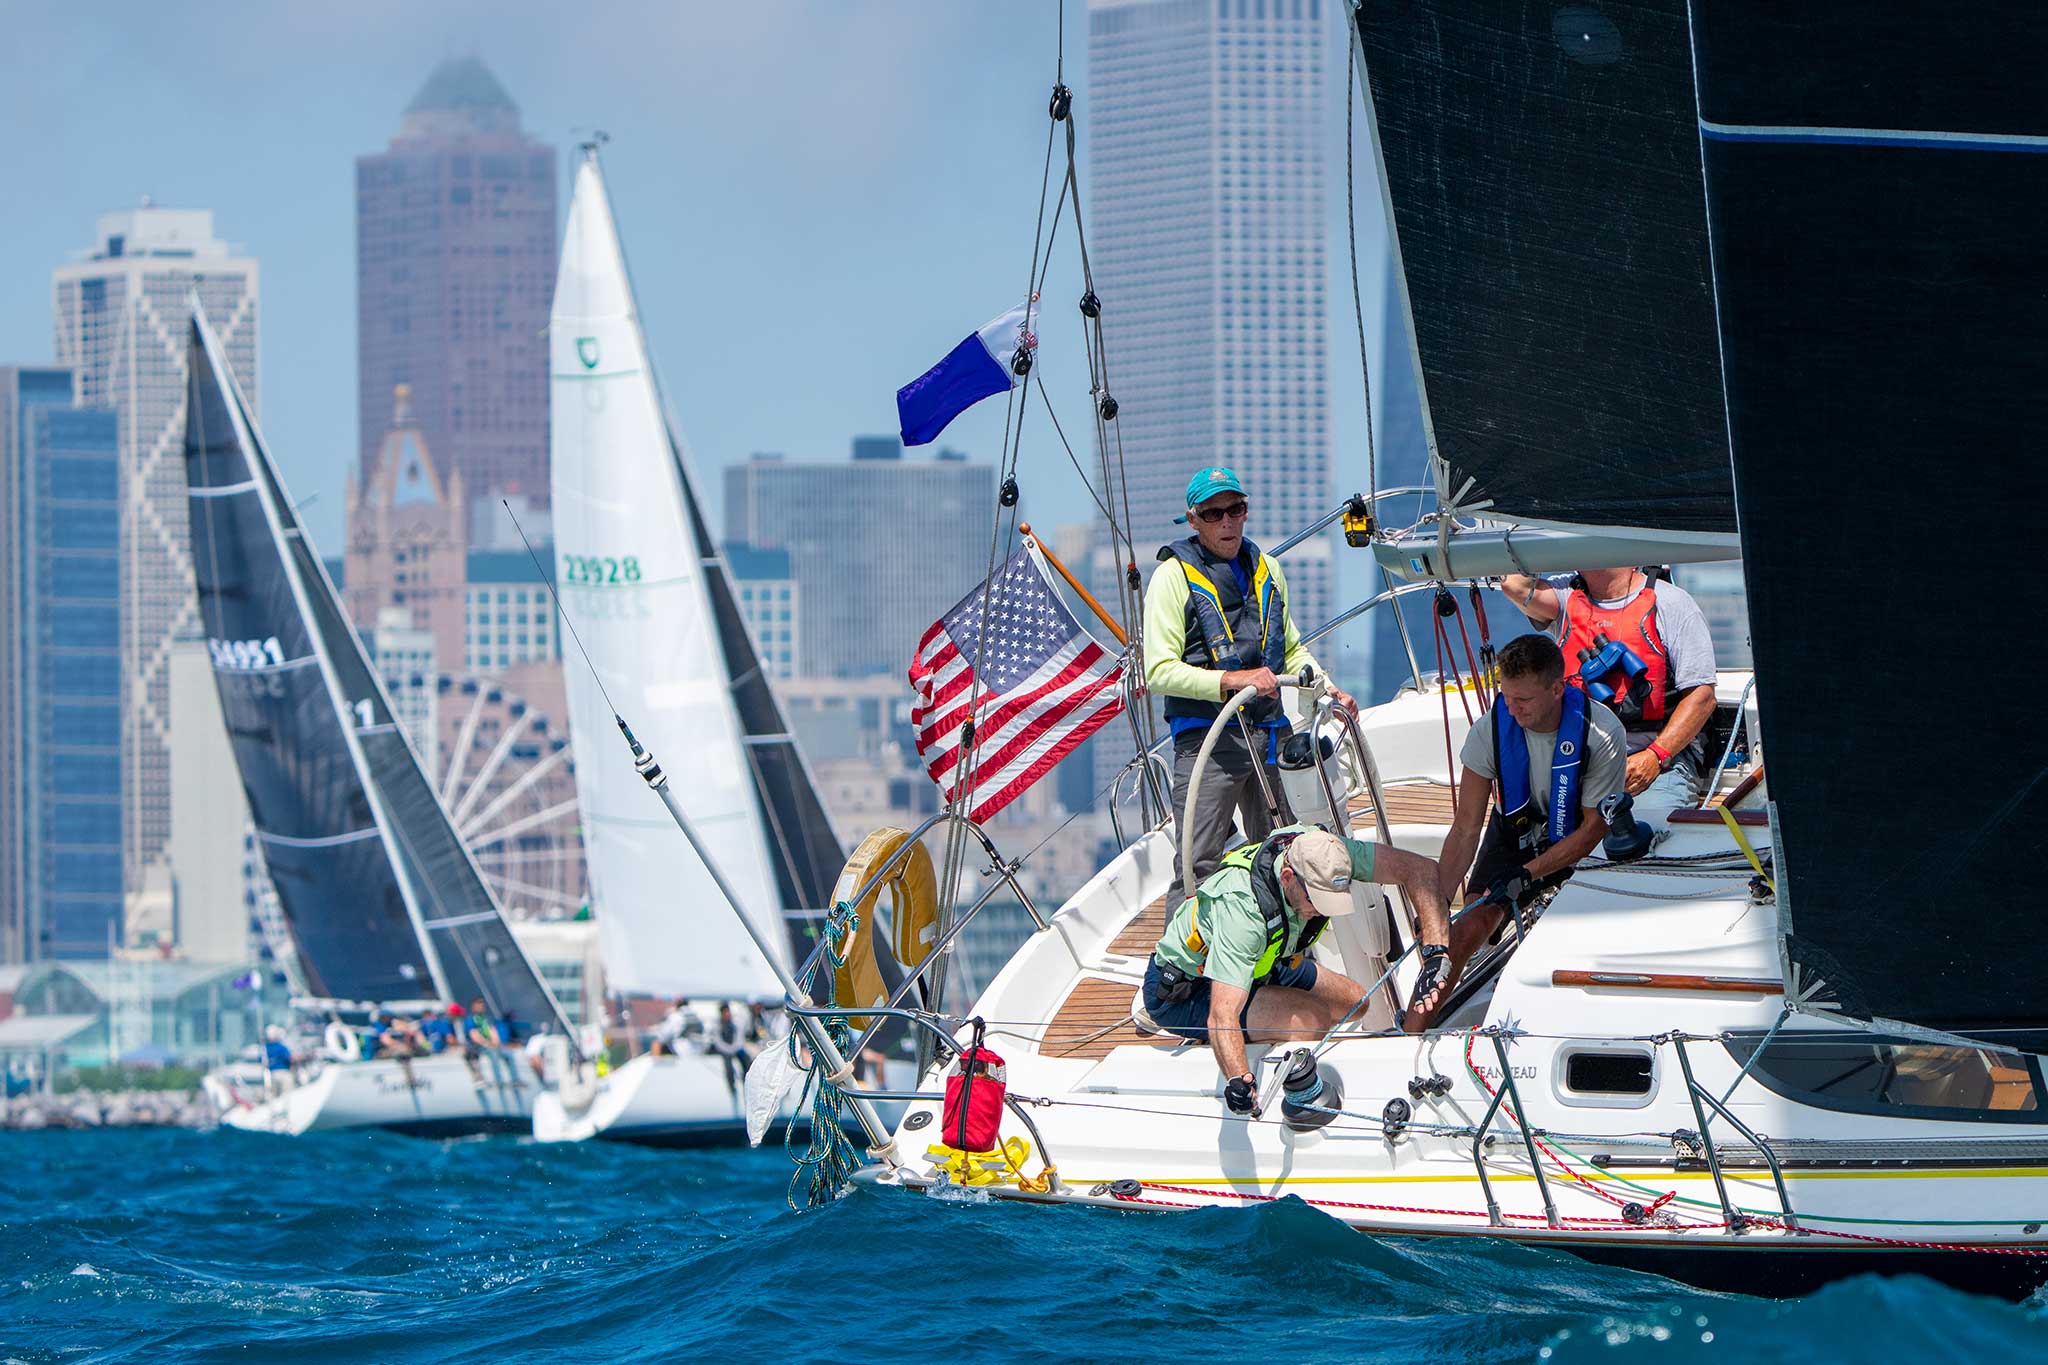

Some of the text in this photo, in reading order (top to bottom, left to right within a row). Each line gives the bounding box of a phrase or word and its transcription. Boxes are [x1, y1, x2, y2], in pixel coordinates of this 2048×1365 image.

[563, 554, 641, 583] 23928
[1556, 786, 1568, 837] West Marine
[1476, 1066, 1537, 1079] EANEAU
